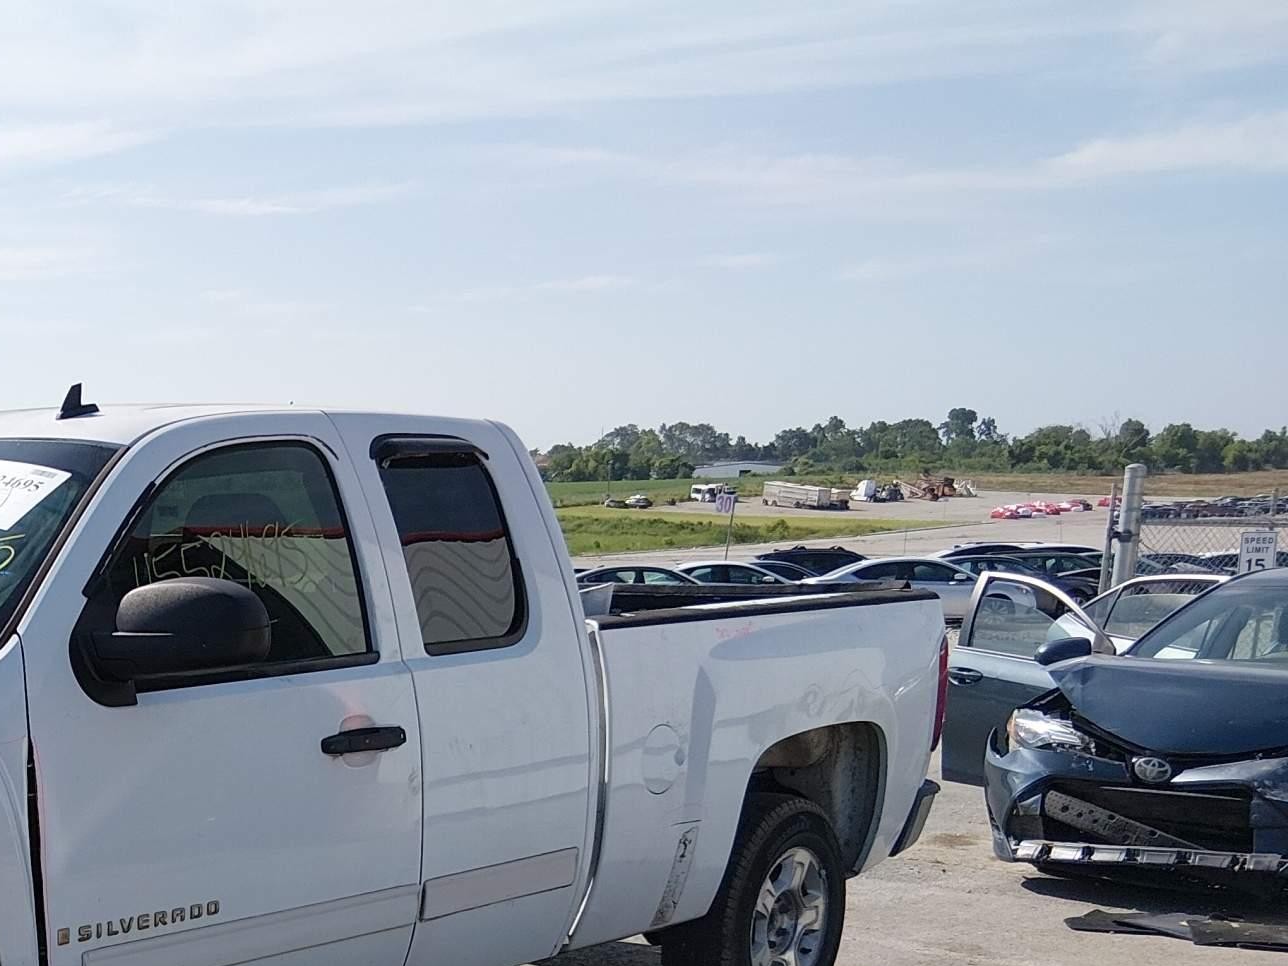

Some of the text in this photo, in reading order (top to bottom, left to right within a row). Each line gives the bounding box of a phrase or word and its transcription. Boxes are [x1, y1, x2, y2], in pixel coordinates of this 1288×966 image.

[716, 495, 732, 512] 30
[1244, 536, 1274, 544] SPEED
[1246, 558, 1265, 571] 15
[77, 900, 220, 942] SILVERADO
